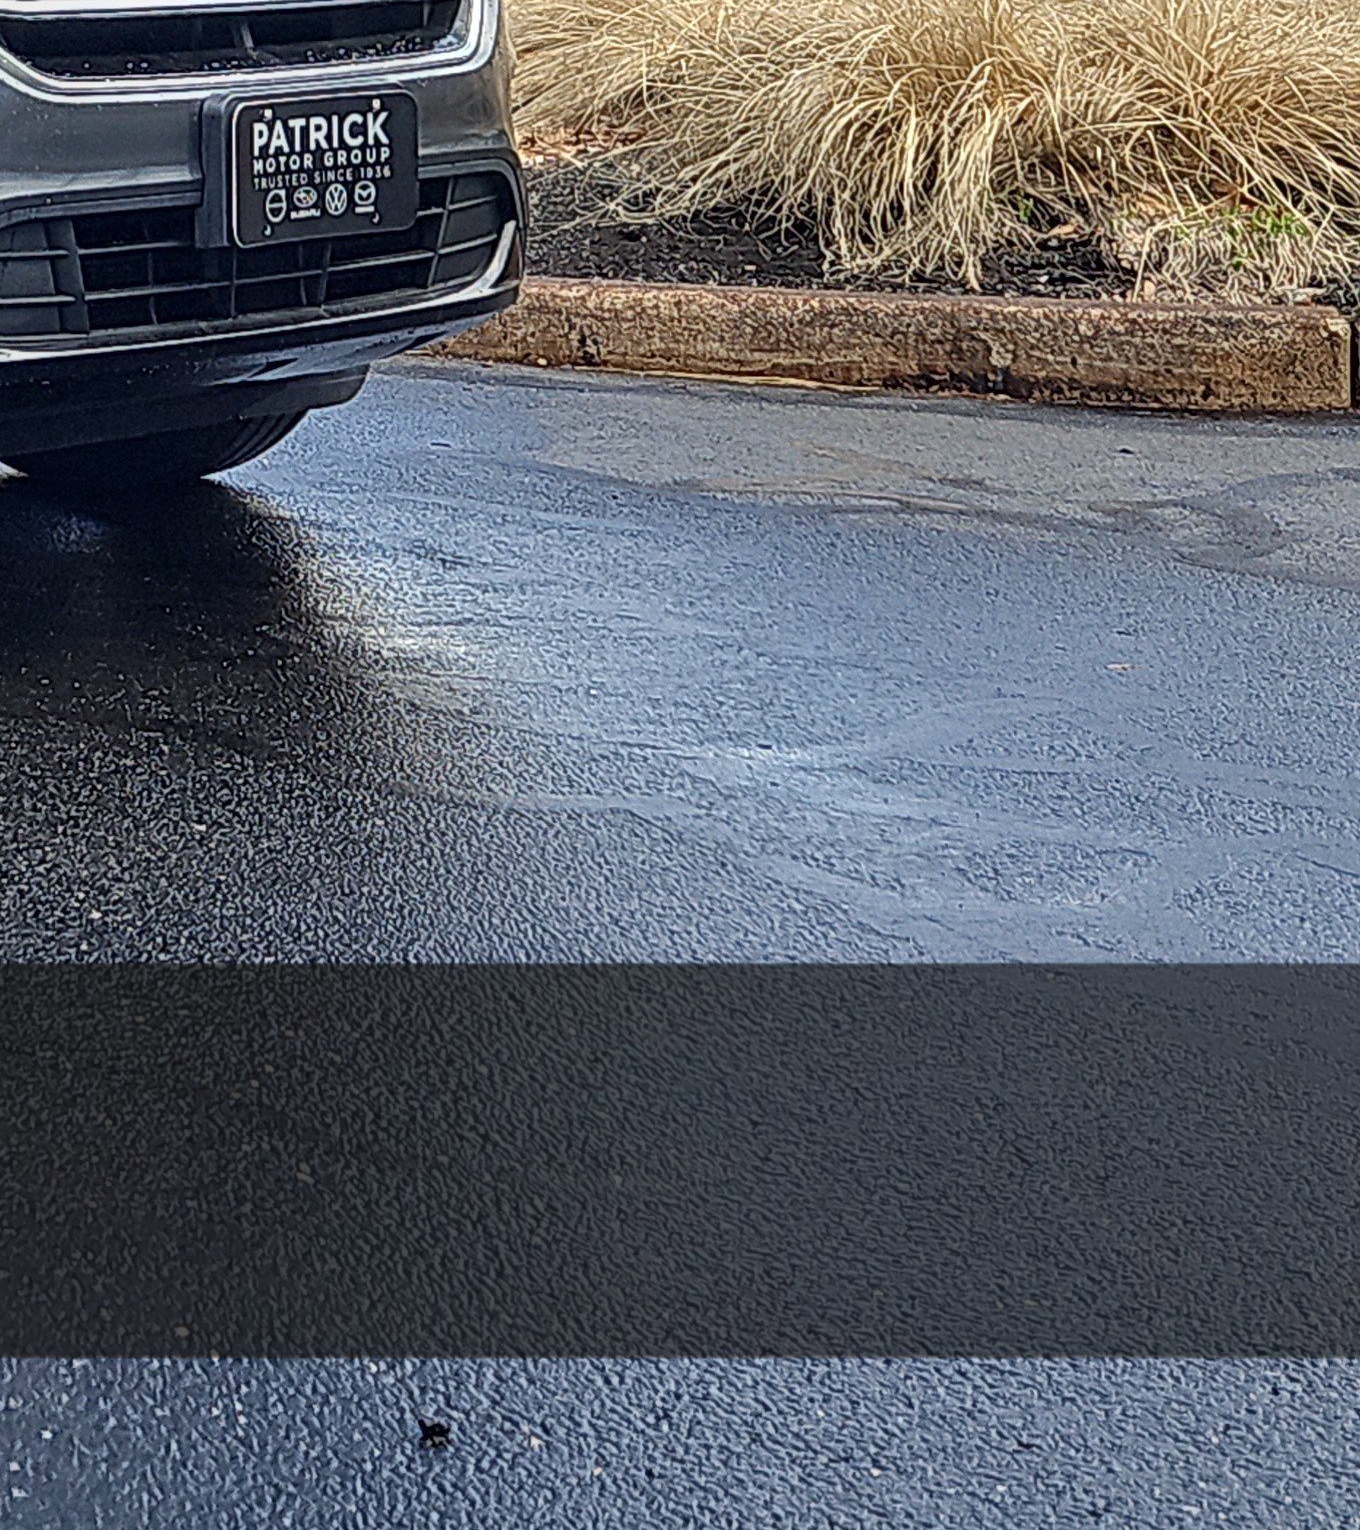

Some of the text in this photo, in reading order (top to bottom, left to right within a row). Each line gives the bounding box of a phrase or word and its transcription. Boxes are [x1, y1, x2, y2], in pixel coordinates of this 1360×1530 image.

[253, 111, 390, 157] PATRICK
[253, 147, 391, 176] MOTOR GROUP
[254, 173, 309, 190] TRUSTED
[314, 168, 354, 185] SINCE
